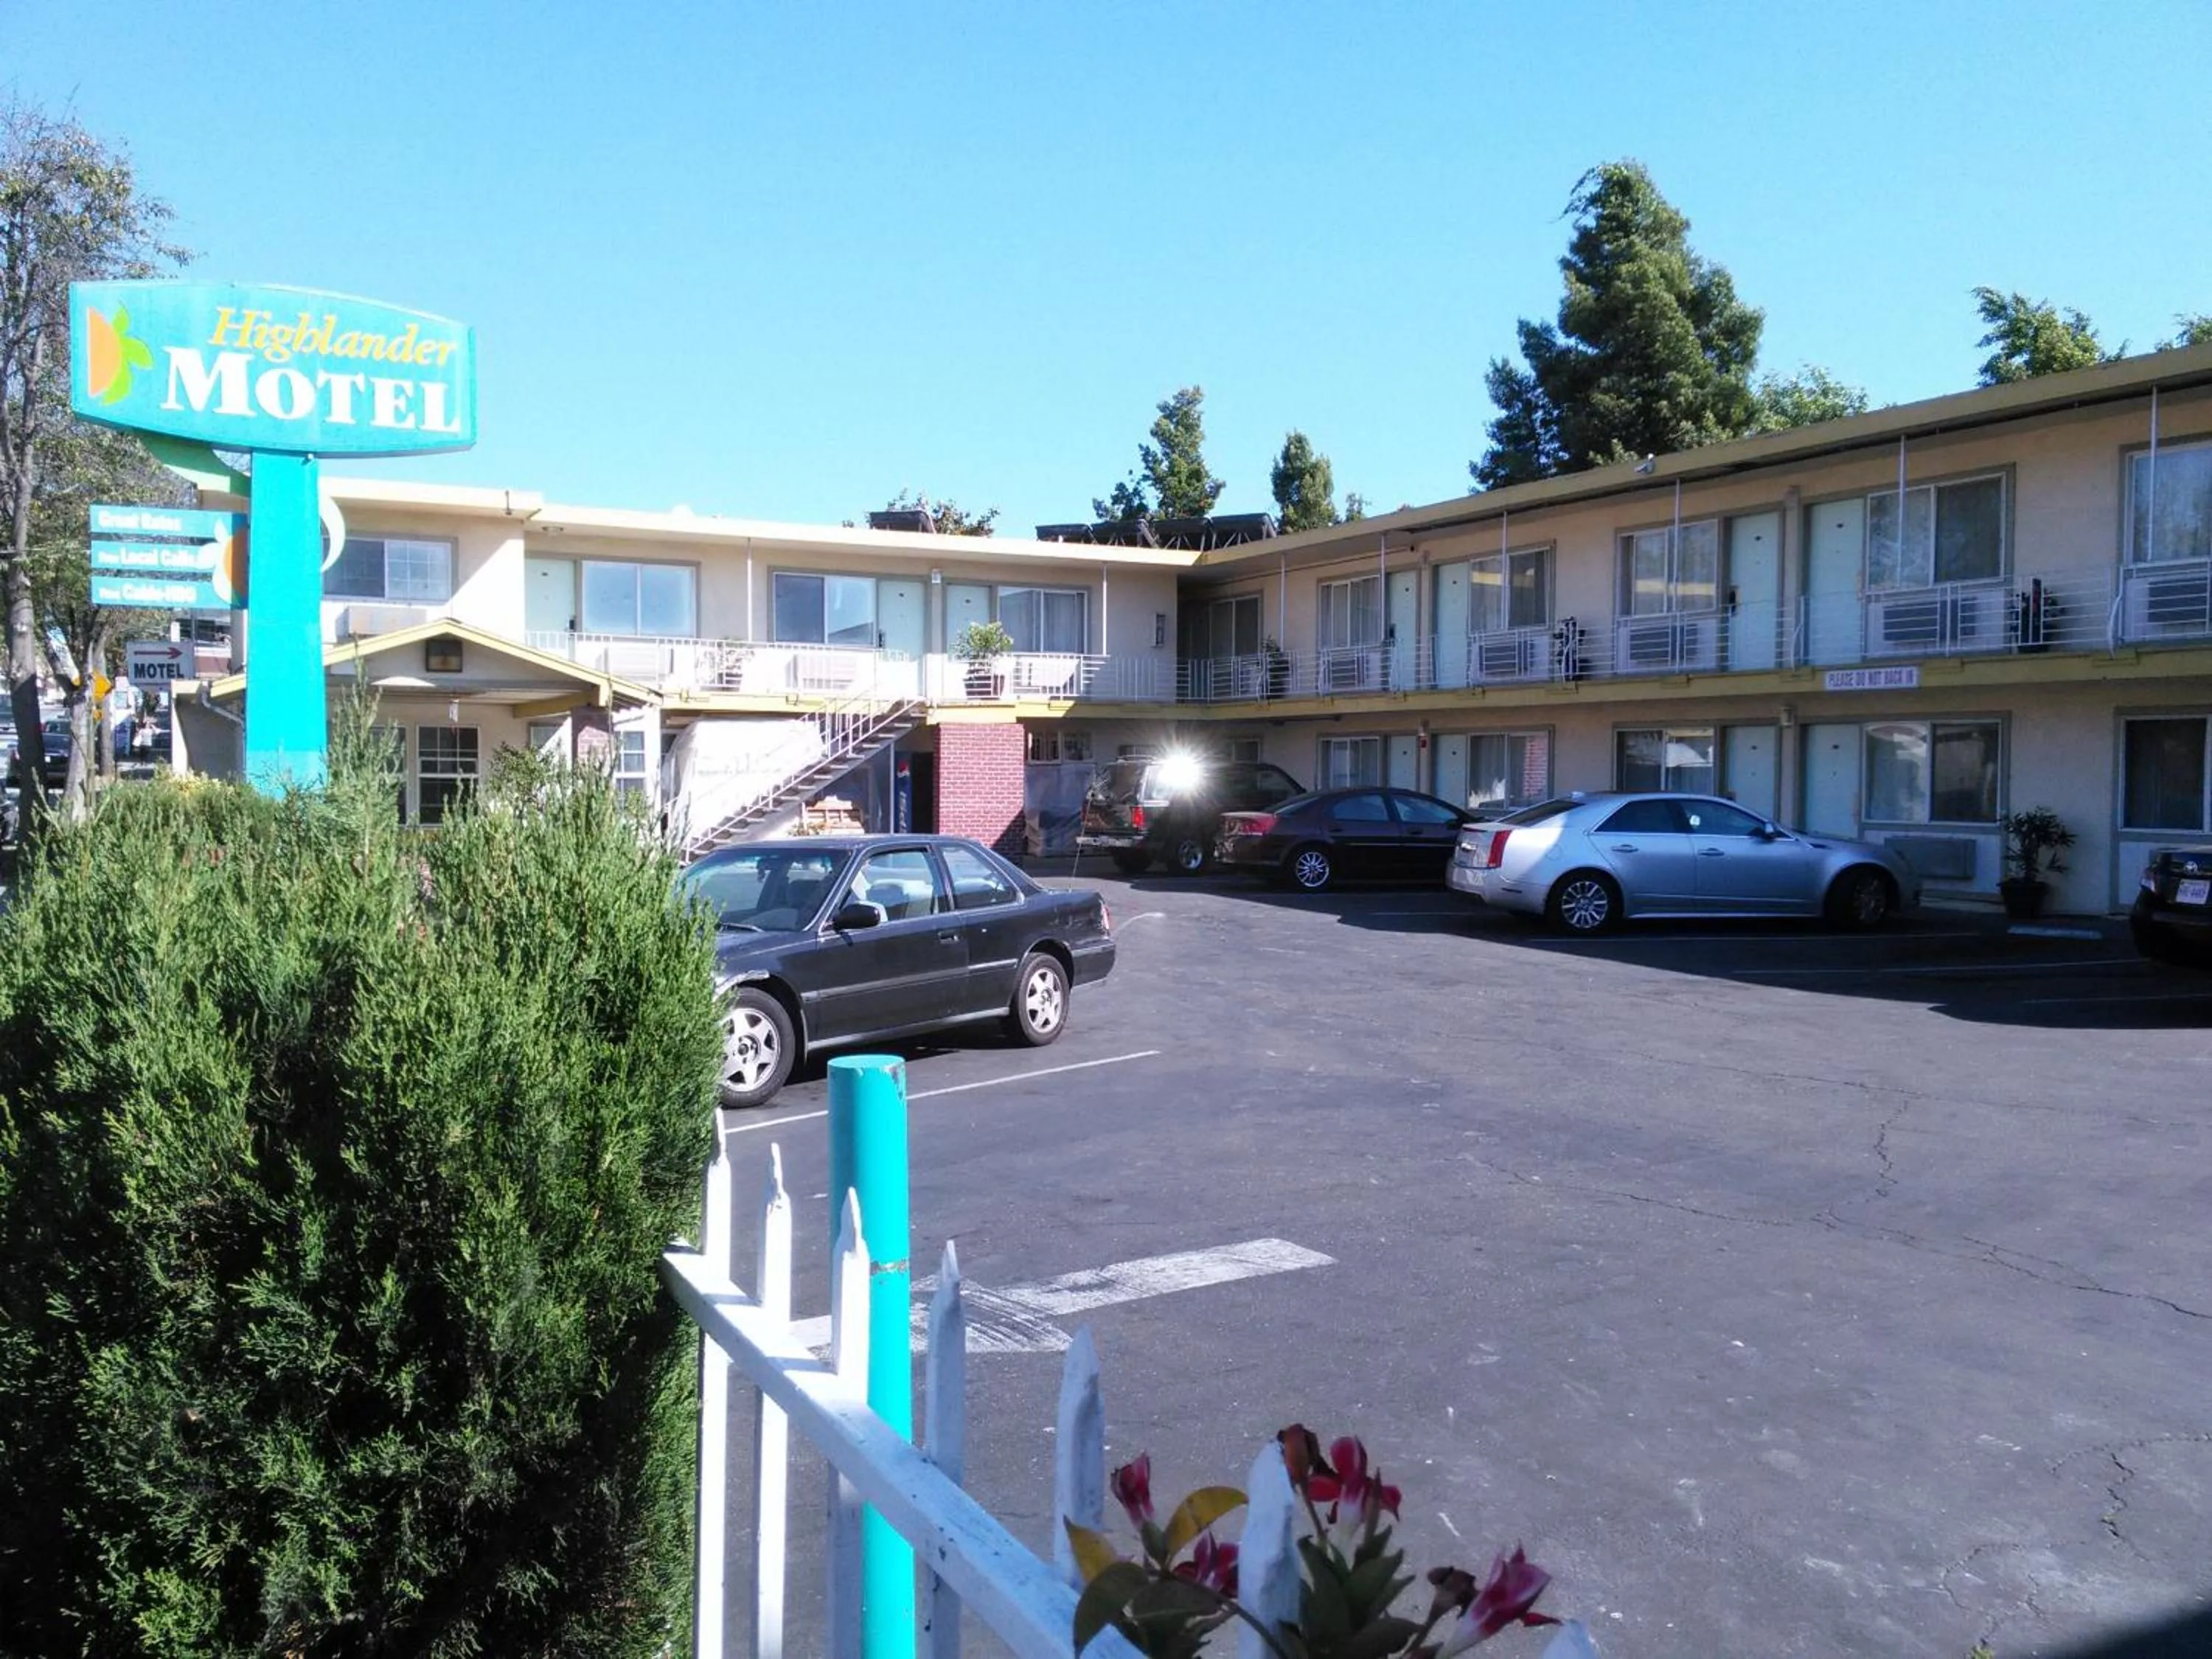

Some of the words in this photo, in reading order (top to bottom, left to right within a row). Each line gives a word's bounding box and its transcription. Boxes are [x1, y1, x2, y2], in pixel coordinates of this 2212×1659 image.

[207, 305, 459, 366] Highlander
[160, 345, 462, 434] MOTEL
[133, 663, 184, 678] MOTEL
[1868, 669, 1882, 686] NOT
